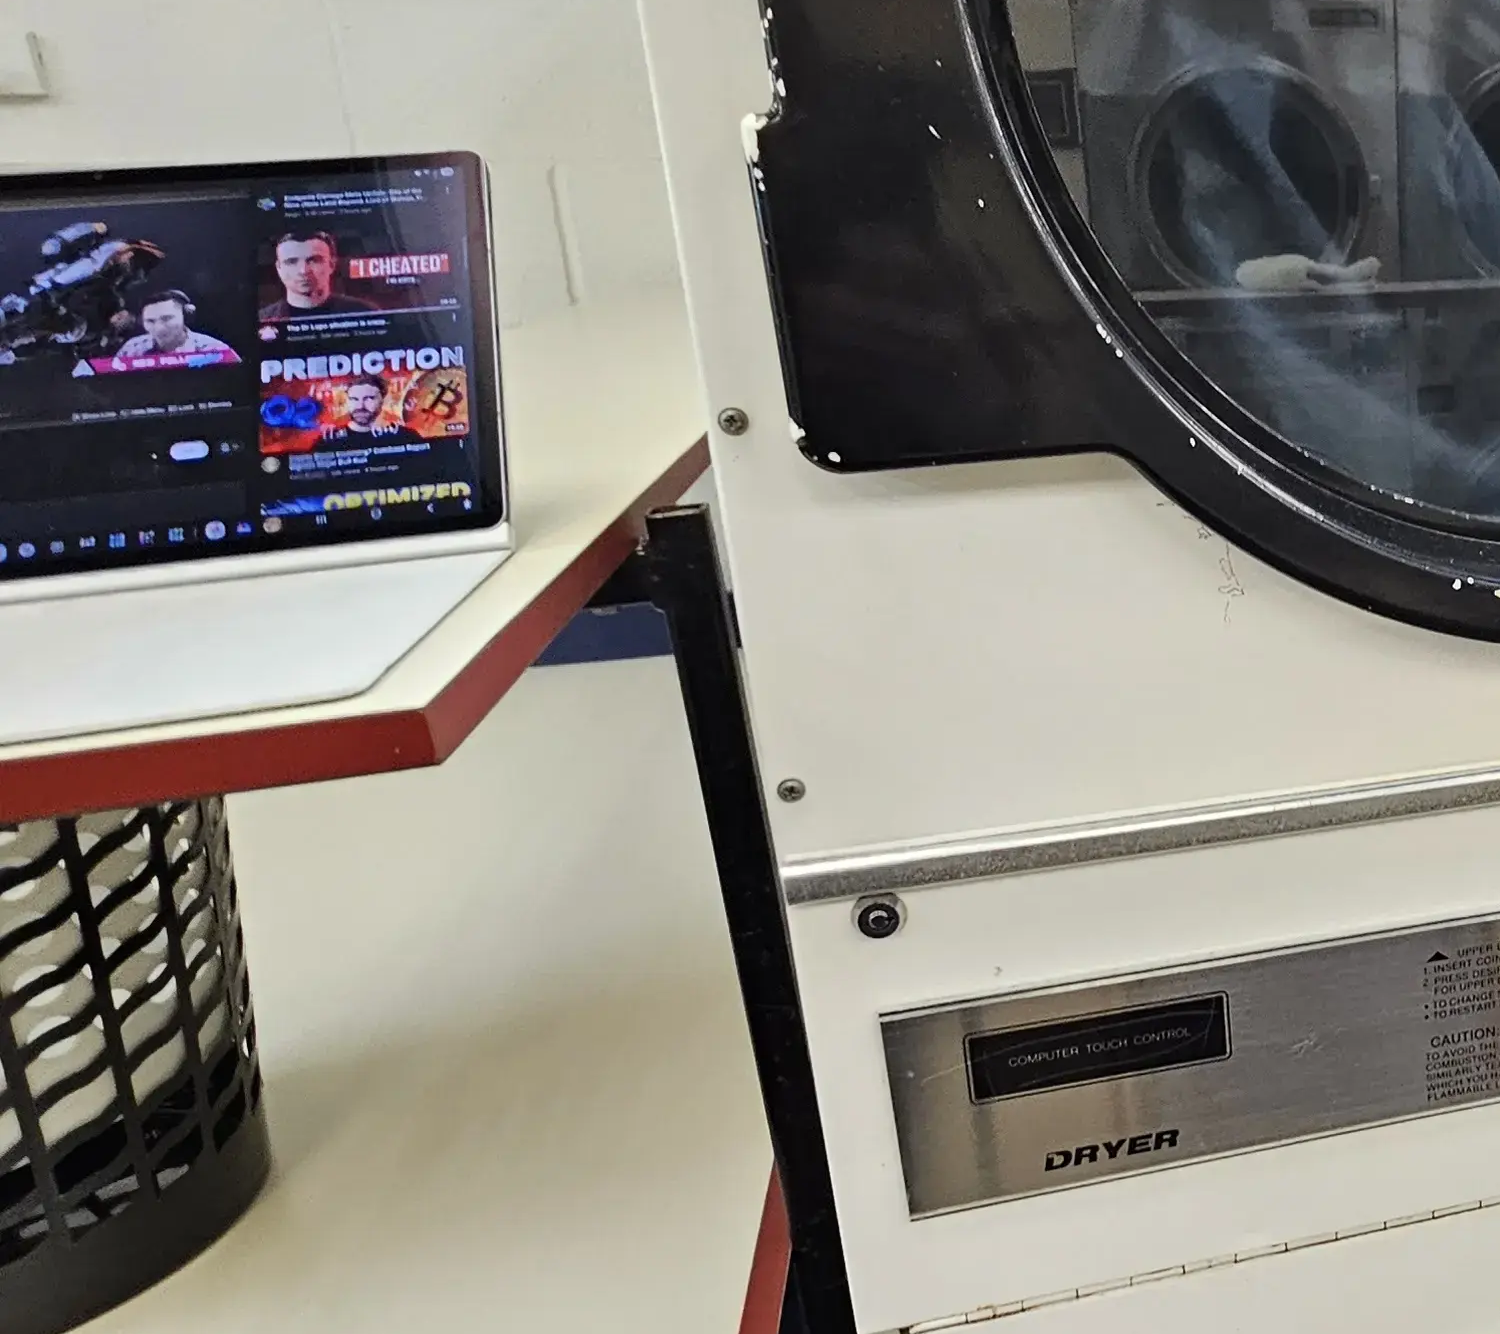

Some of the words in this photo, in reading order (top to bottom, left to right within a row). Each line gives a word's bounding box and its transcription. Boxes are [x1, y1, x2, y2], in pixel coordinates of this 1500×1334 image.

[260, 346, 464, 383] PREDICTION
[1457, 943, 1492, 958] UPPER
[1433, 958, 1472, 974] INSERT
[1433, 970, 1468, 986] PRESS
[1433, 983, 1456, 996] FOR
[1459, 976, 1493, 991] UPPER
[1007, 1045, 1079, 1068] COMPUTER
[1085, 1036, 1129, 1054] TOUCH
[1132, 1025, 1191, 1046] CONTROL
[1430, 1023, 1499, 1049] CAUTION:
[1042, 1127, 1181, 1172] DRYER
